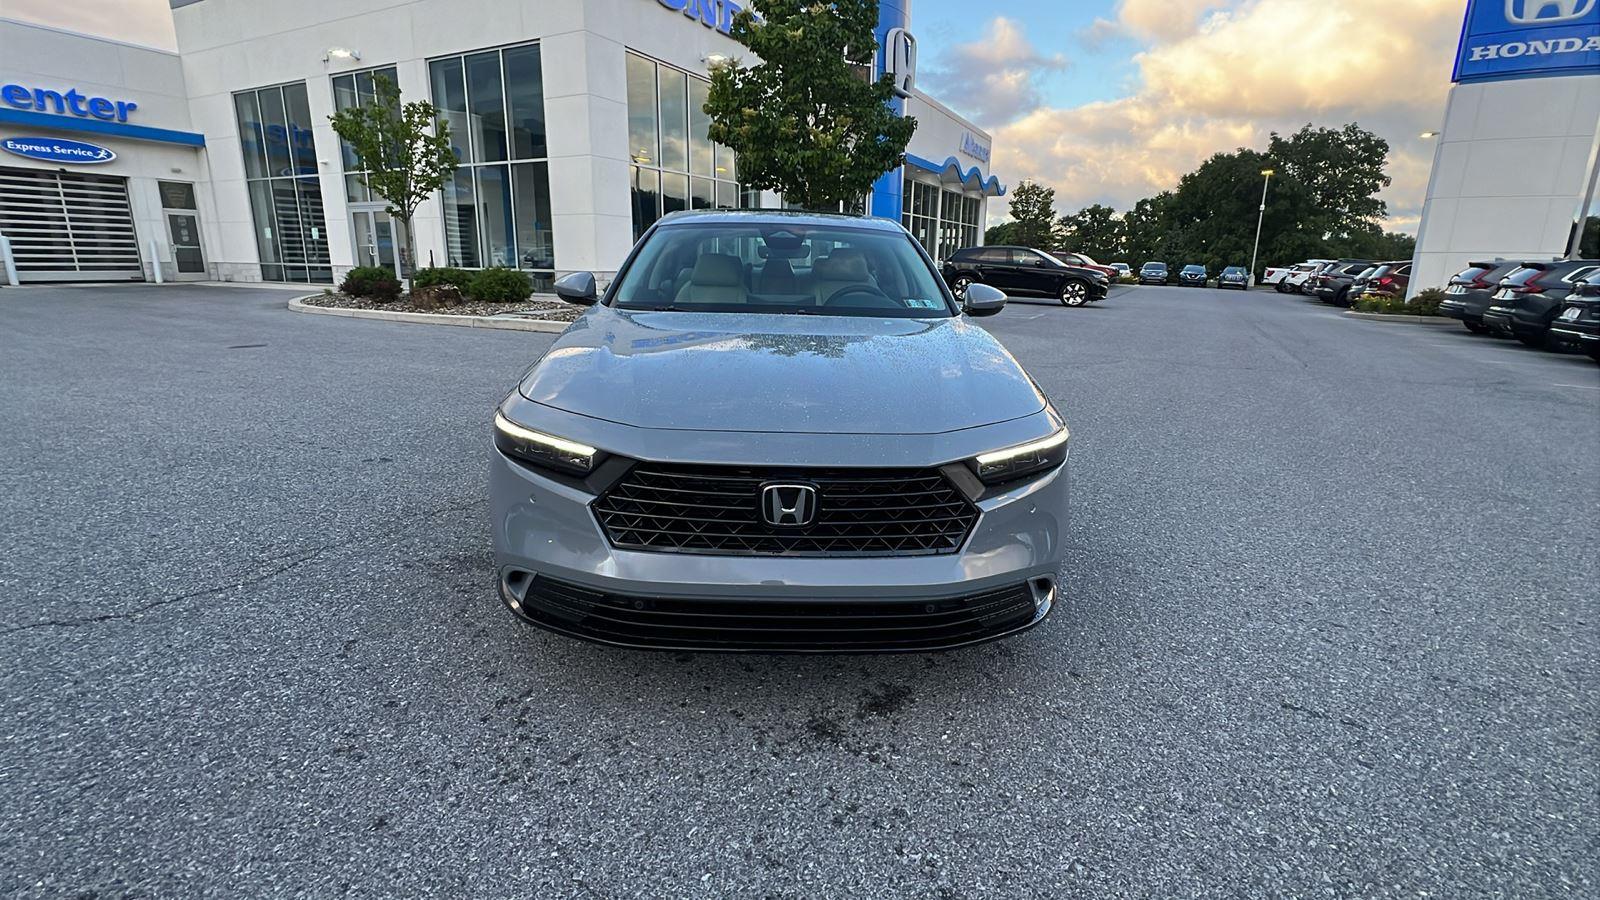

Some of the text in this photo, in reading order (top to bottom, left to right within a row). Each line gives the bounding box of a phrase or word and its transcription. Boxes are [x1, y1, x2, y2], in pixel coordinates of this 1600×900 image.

[1, 84, 137, 122] enter
[7, 141, 94, 157] Express Service
